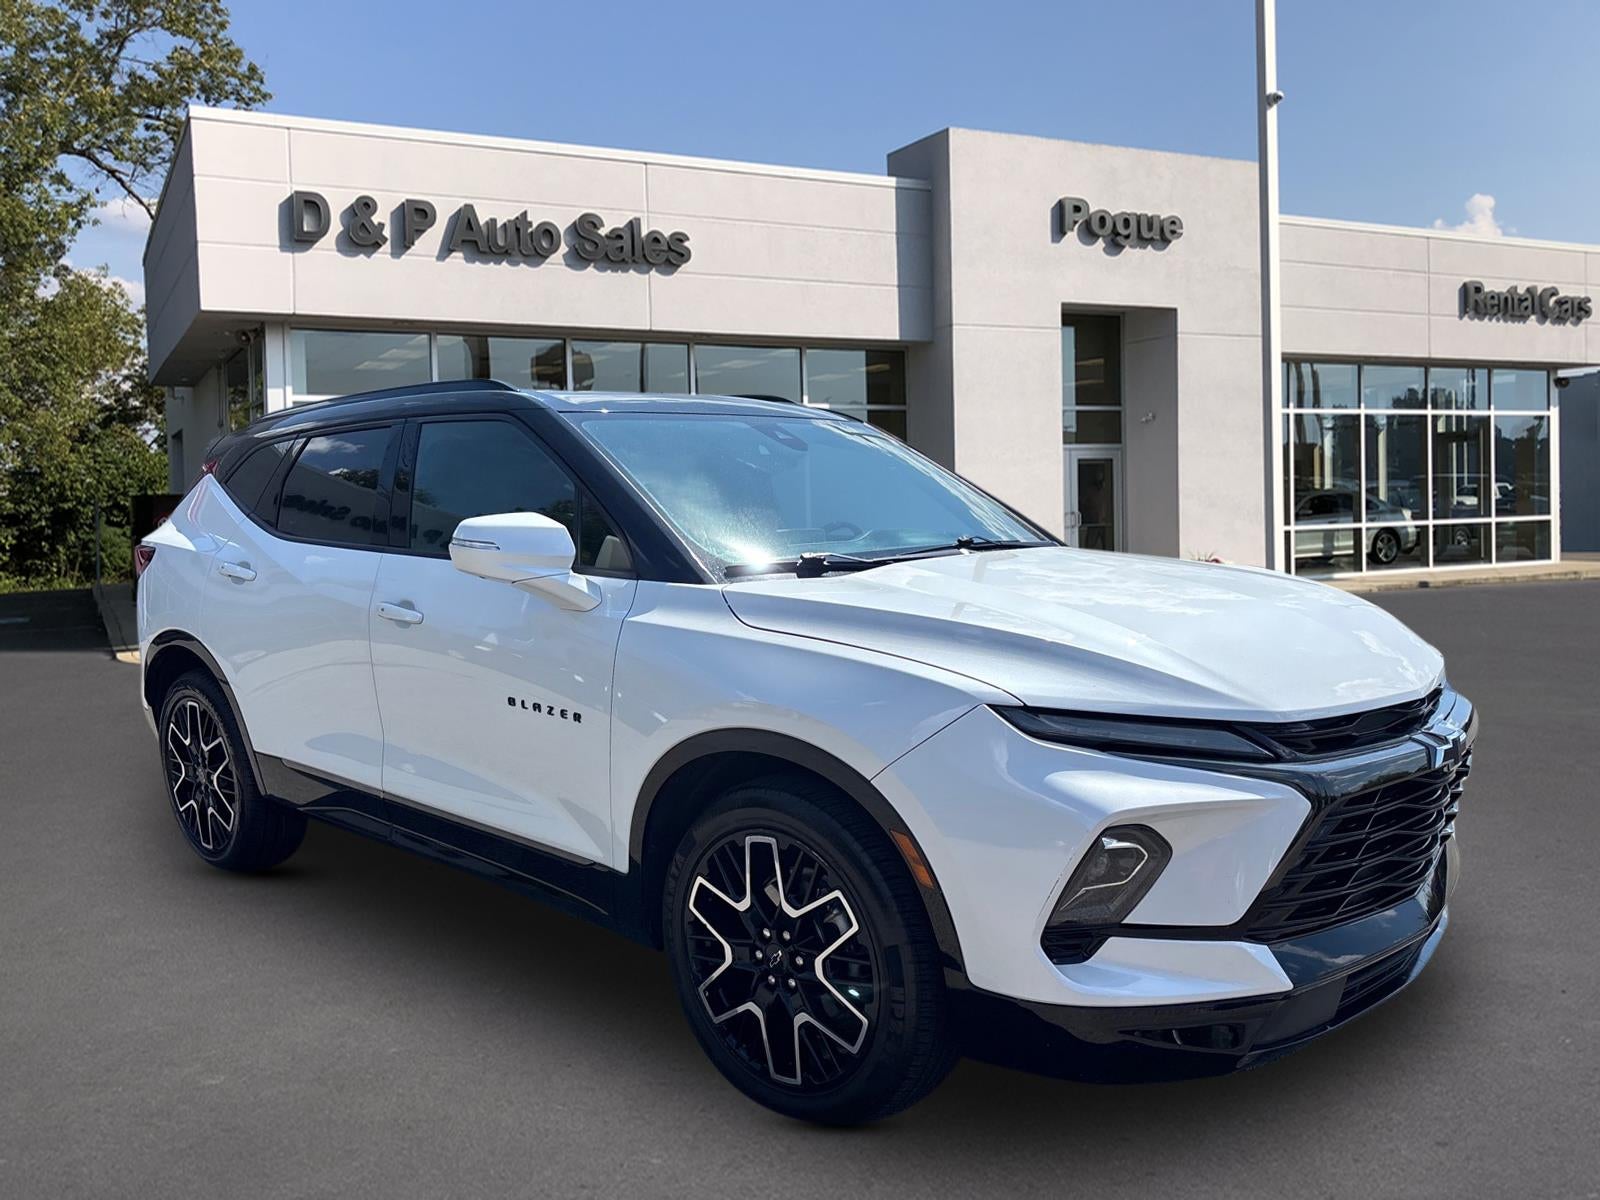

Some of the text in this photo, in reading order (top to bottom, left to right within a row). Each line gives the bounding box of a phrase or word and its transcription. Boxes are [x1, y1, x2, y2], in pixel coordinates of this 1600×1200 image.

[292, 190, 692, 267] D & P Auto Sales
[1060, 197, 1184, 248] Pogue
[1462, 280, 1593, 321] Rental Cars
[507, 695, 582, 724] BLAZER
